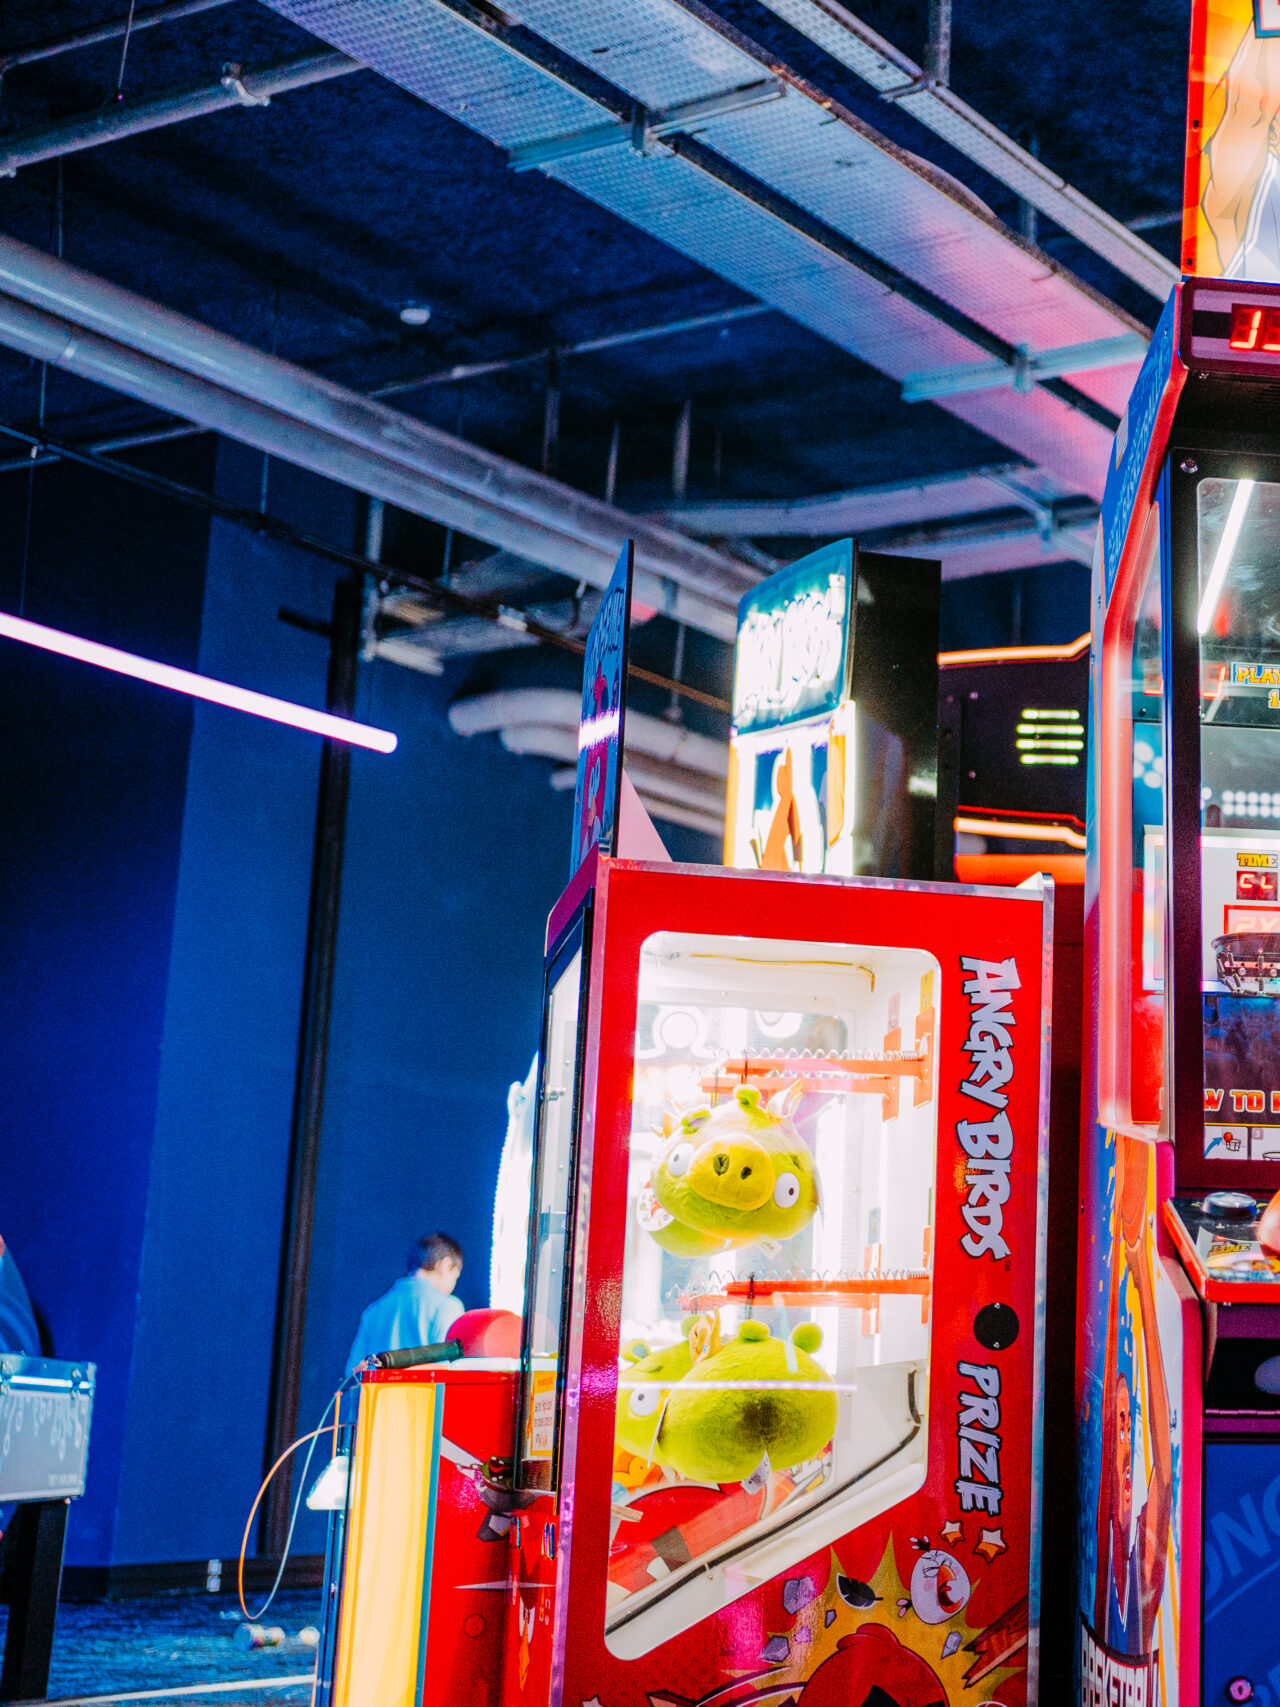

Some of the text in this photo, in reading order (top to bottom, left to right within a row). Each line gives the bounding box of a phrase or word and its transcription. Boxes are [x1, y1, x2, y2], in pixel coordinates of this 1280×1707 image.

[1268, 689, 1280, 709] 1
[1236, 853, 1278, 868] TIME
[955, 956, 1021, 1261] ANGRY BIRDS
[1230, 1089, 1265, 1113] TO
[954, 1360, 1004, 1517] PRIZE
